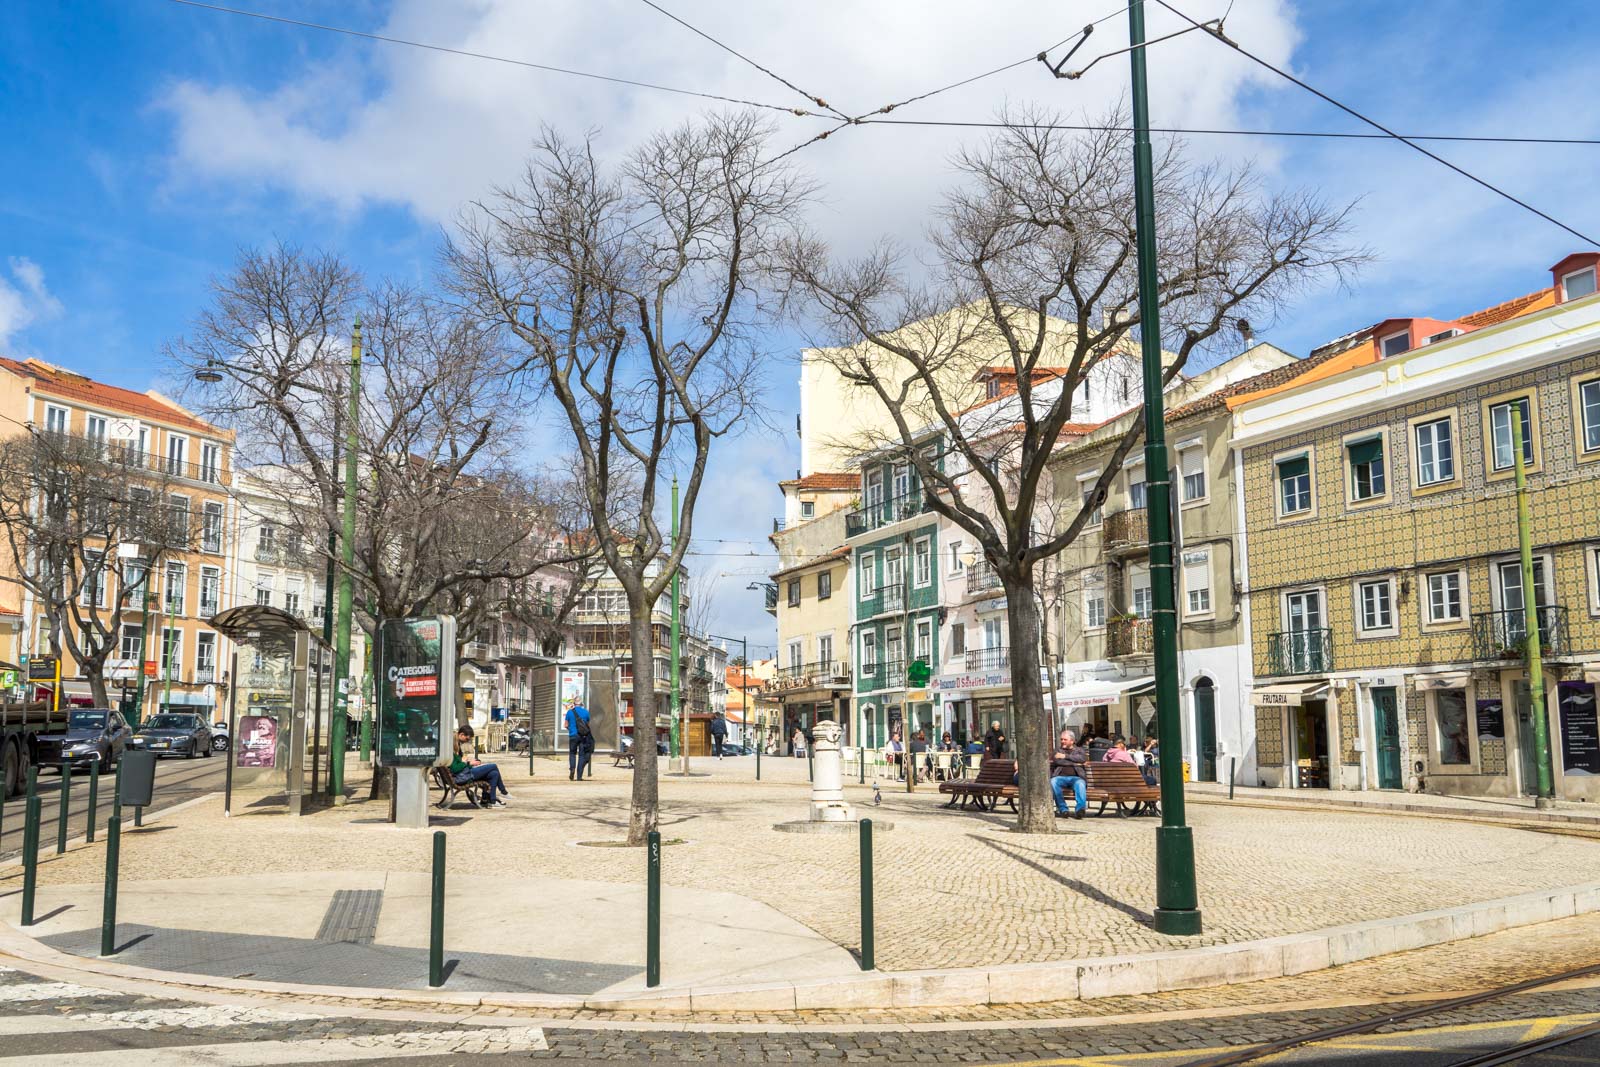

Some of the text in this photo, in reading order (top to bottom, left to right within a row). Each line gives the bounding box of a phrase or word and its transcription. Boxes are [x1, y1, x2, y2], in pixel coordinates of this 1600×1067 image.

[388, 665, 436, 681] CATEGORIA
[395, 676, 405, 699] 5
[1262, 694, 1288, 704] FRUTARIA
